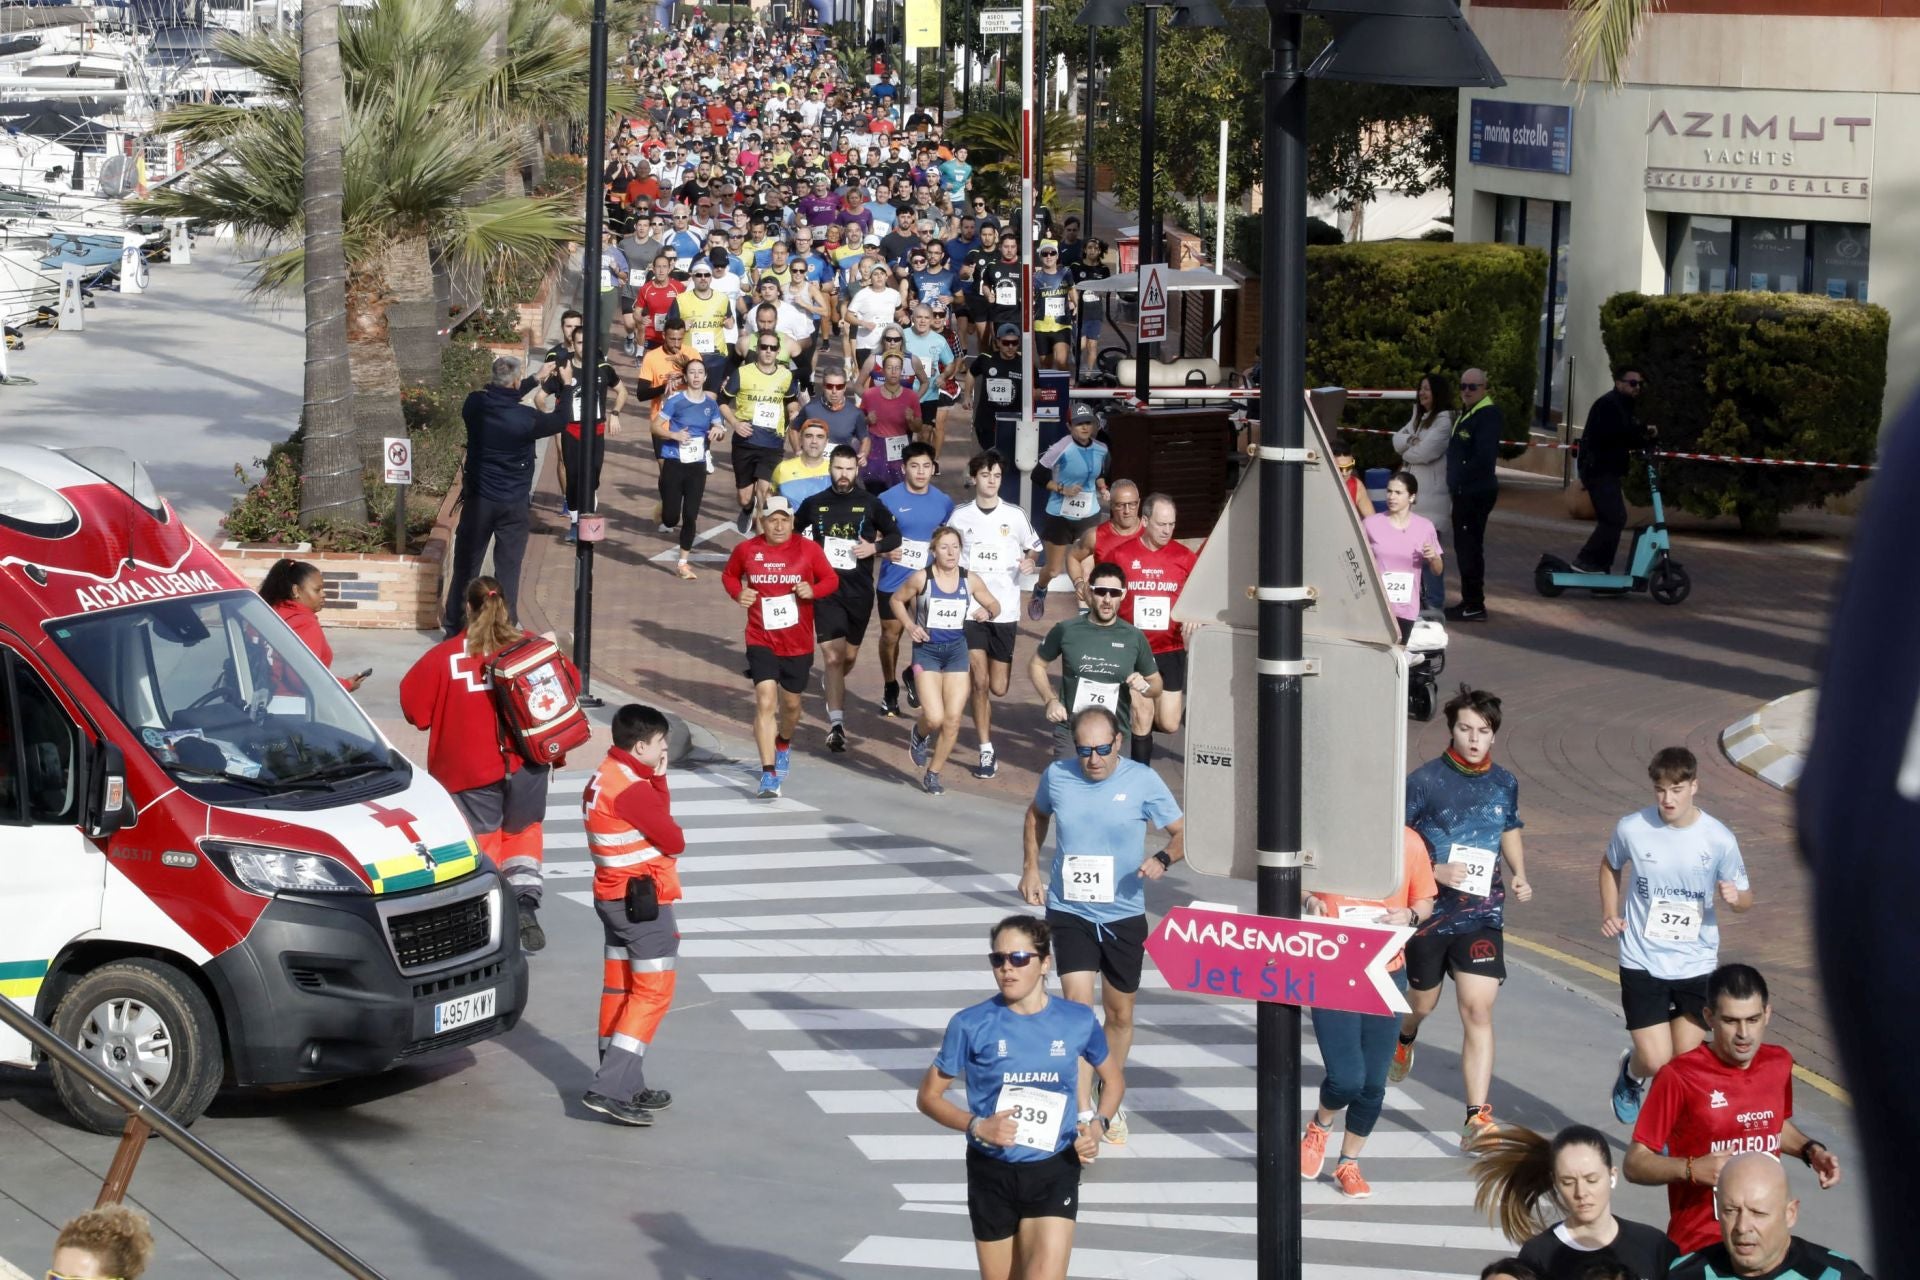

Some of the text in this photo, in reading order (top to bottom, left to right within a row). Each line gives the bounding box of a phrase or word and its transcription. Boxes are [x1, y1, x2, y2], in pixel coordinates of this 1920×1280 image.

[1645, 109, 1872, 142] AZIMUT
[1484, 120, 1510, 144] marina
[1512, 123, 1548, 147] estrella
[1704, 148, 1795, 166] YACHTS
[1644, 173, 1869, 195] EXCLUSIVE DEALER
[760, 410, 775, 418] 220
[1069, 499, 1085, 508] 443
[833, 548, 847, 557] 32
[902, 548, 922, 559] 239
[977, 552, 998, 561] 445
[1345, 548, 1366, 588] BAN
[750, 574, 802, 584] NUCLEO DURO
[1128, 581, 1178, 592] NUCLEO DURO
[1387, 582, 1406, 591] 224
[773, 607, 787, 616] 84
[936, 610, 958, 618] 444
[1142, 608, 1162, 617] 129
[1090, 693, 1105, 704] 76
[1196, 754, 1232, 768] BAN
[1073, 871, 1100, 884] 231
[1660, 912, 1691, 927] 374
[1187, 959, 1317, 1003] Jet Ski
[442, 992, 494, 1027] 4957 KWY
[1003, 1071, 1060, 1083] BALEARIA
[1736, 1110, 1774, 1123] excom
